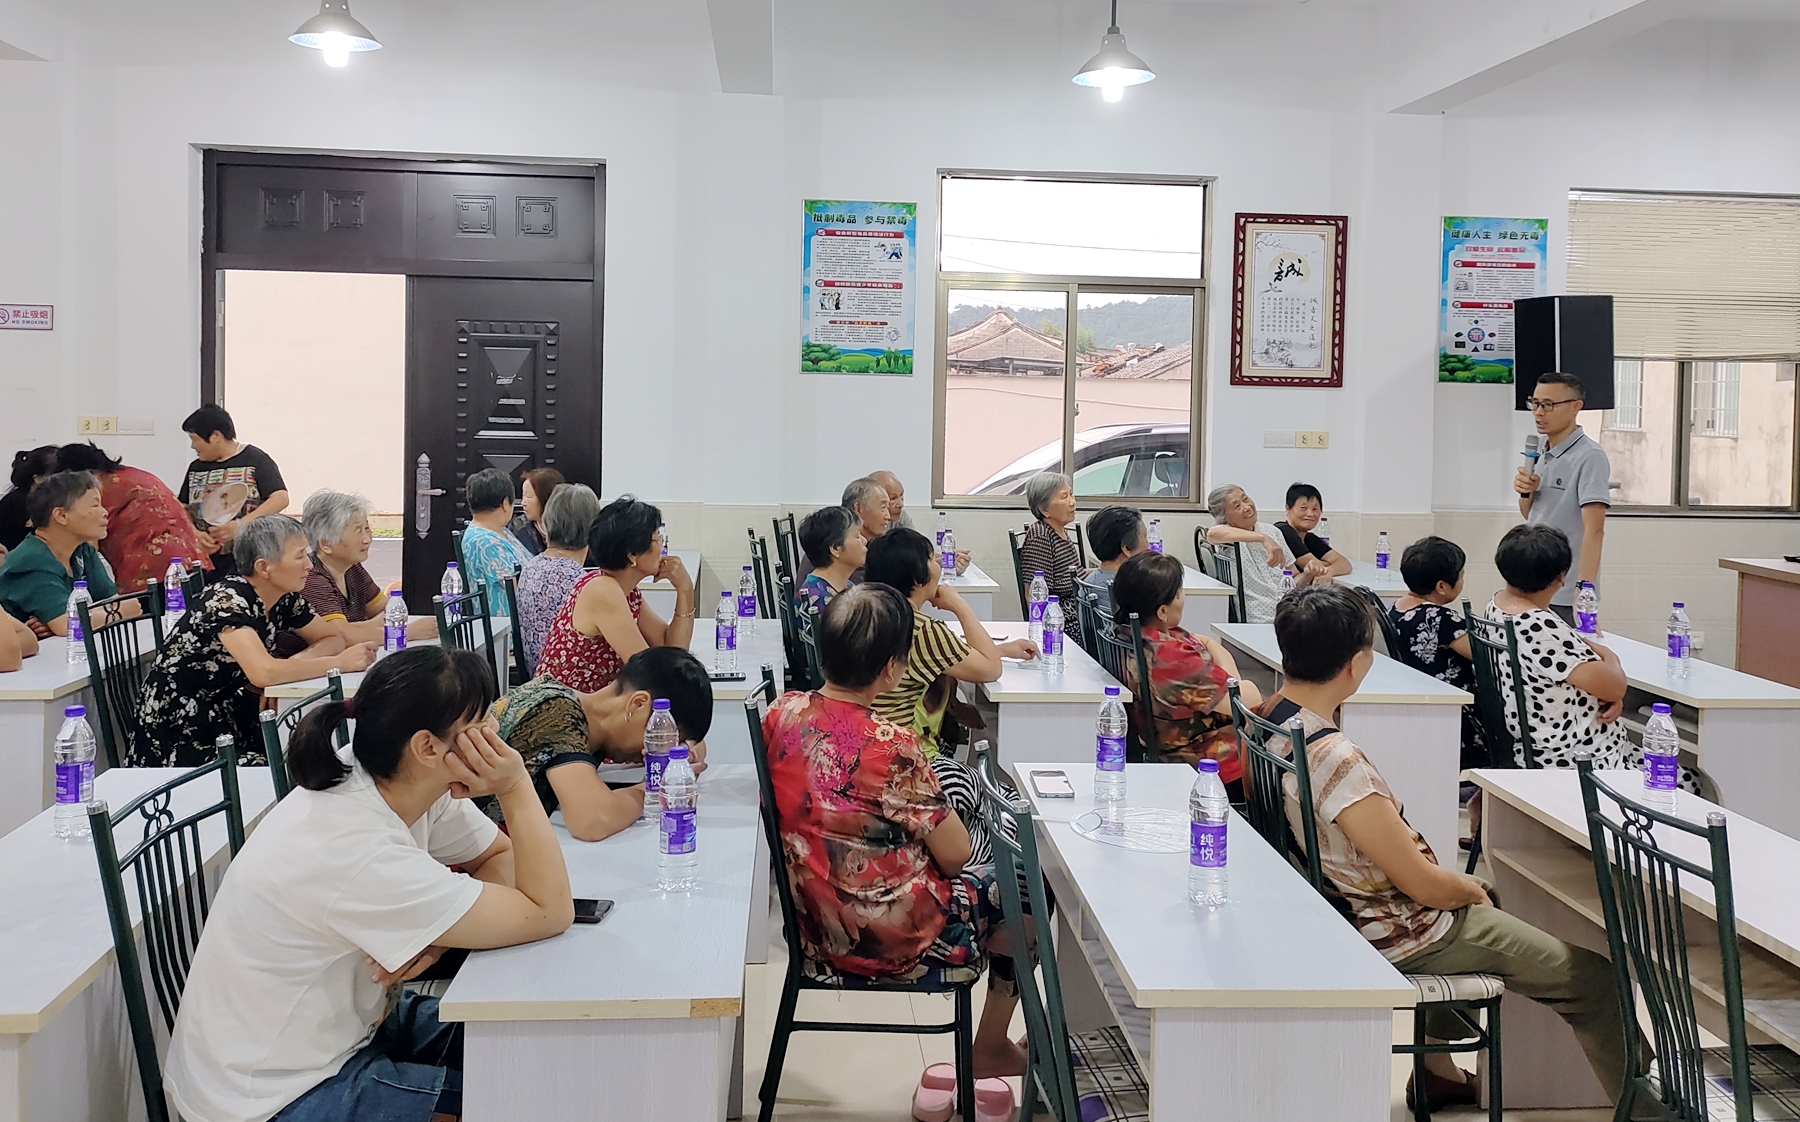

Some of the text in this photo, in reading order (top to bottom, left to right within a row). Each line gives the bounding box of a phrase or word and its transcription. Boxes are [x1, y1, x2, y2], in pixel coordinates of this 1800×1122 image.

[813, 213, 908, 226] 抵制毒品 参与禁毒
[1451, 230, 1540, 241] 健康人生 绿色无毒
[12, 310, 48, 319] 禁止吸烟
[650, 761, 661, 786] 纯悦
[1200, 833, 1214, 861] 纯悦
